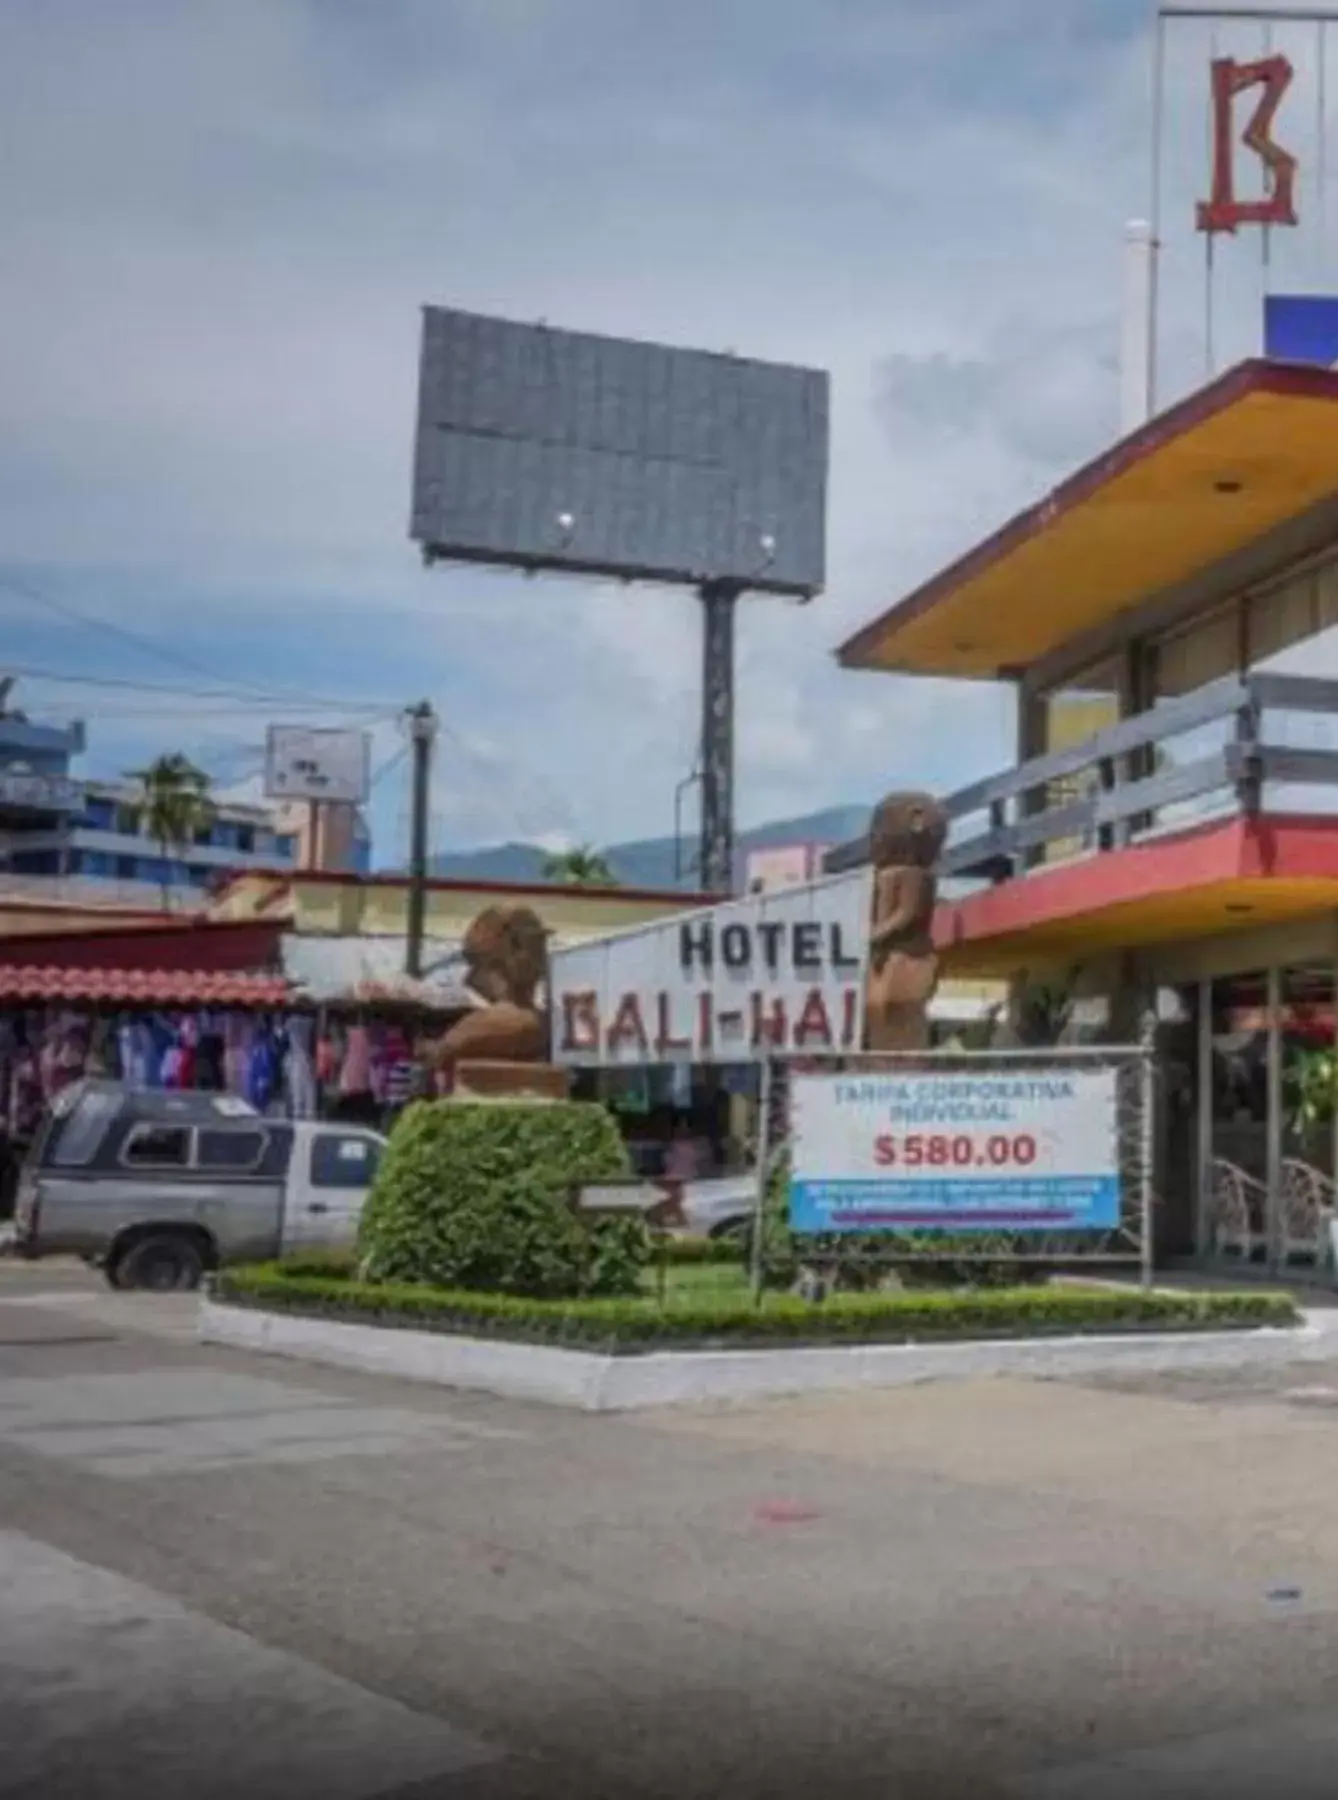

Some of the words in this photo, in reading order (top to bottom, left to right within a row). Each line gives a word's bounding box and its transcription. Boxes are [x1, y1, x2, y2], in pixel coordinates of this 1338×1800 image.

[680, 922, 859, 967] HOTEL
[561, 987, 857, 1053] BALI-HAI
[873, 1133, 1036, 1166] $580.00
